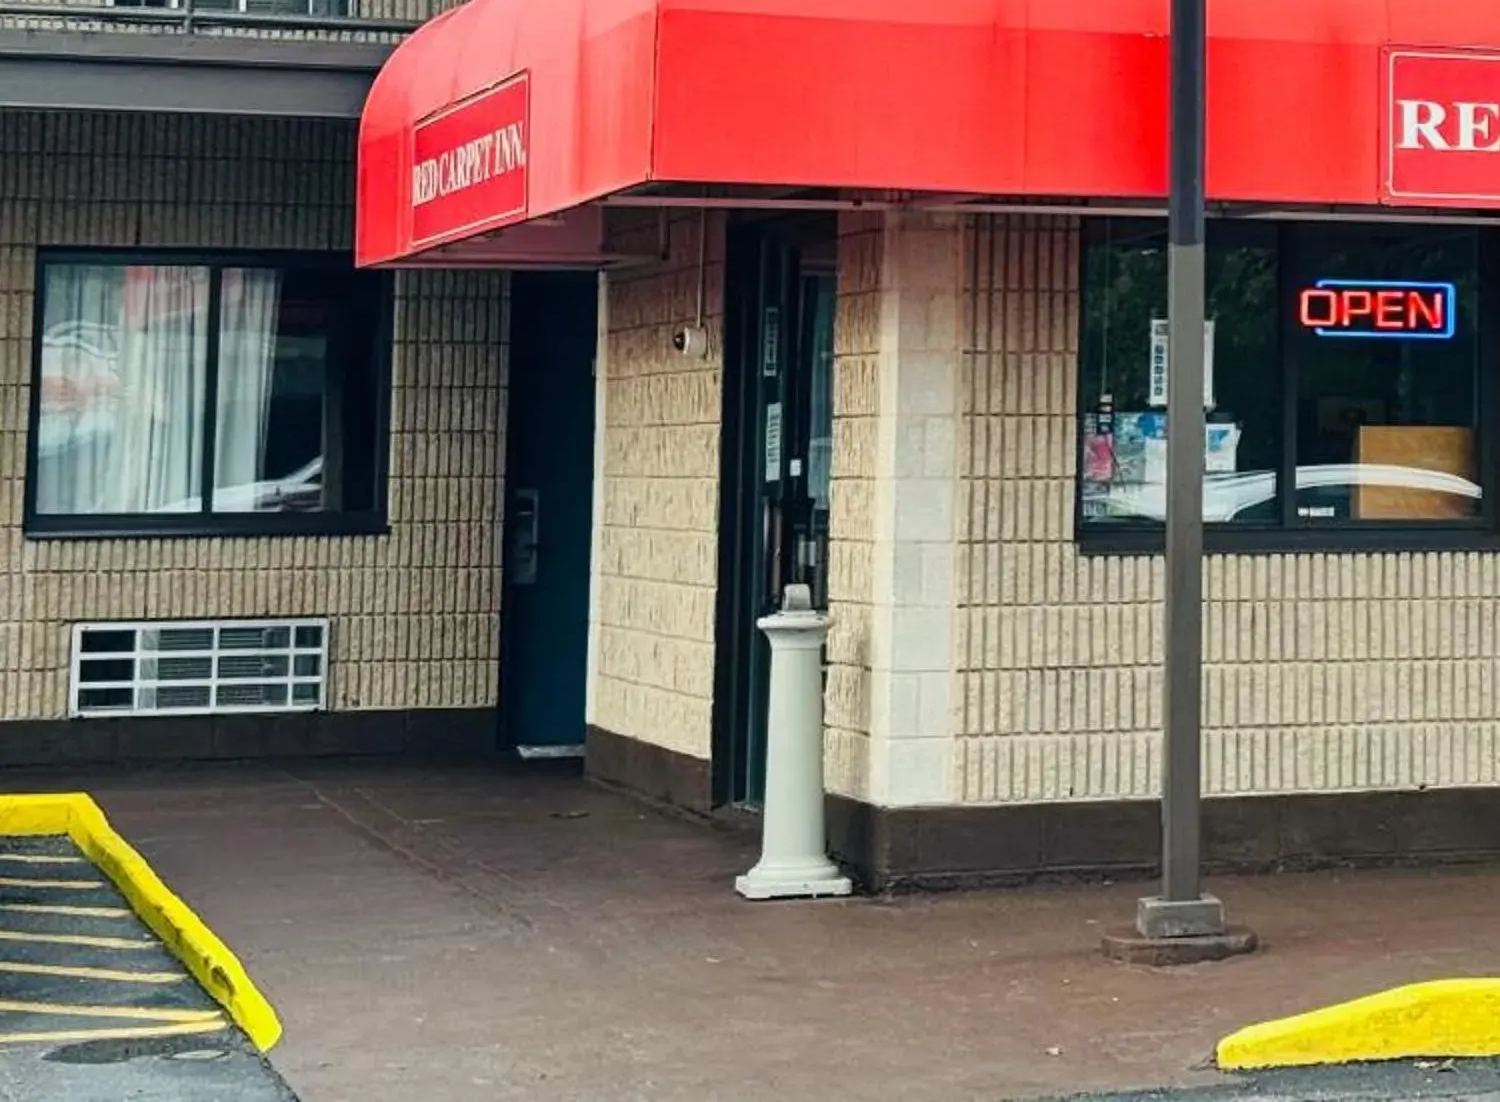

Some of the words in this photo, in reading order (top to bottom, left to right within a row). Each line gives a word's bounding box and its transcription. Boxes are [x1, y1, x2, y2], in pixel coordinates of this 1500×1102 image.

[412, 159, 438, 207] RED
[440, 135, 493, 196] CARPET
[1300, 289, 1442, 329] OPEN
